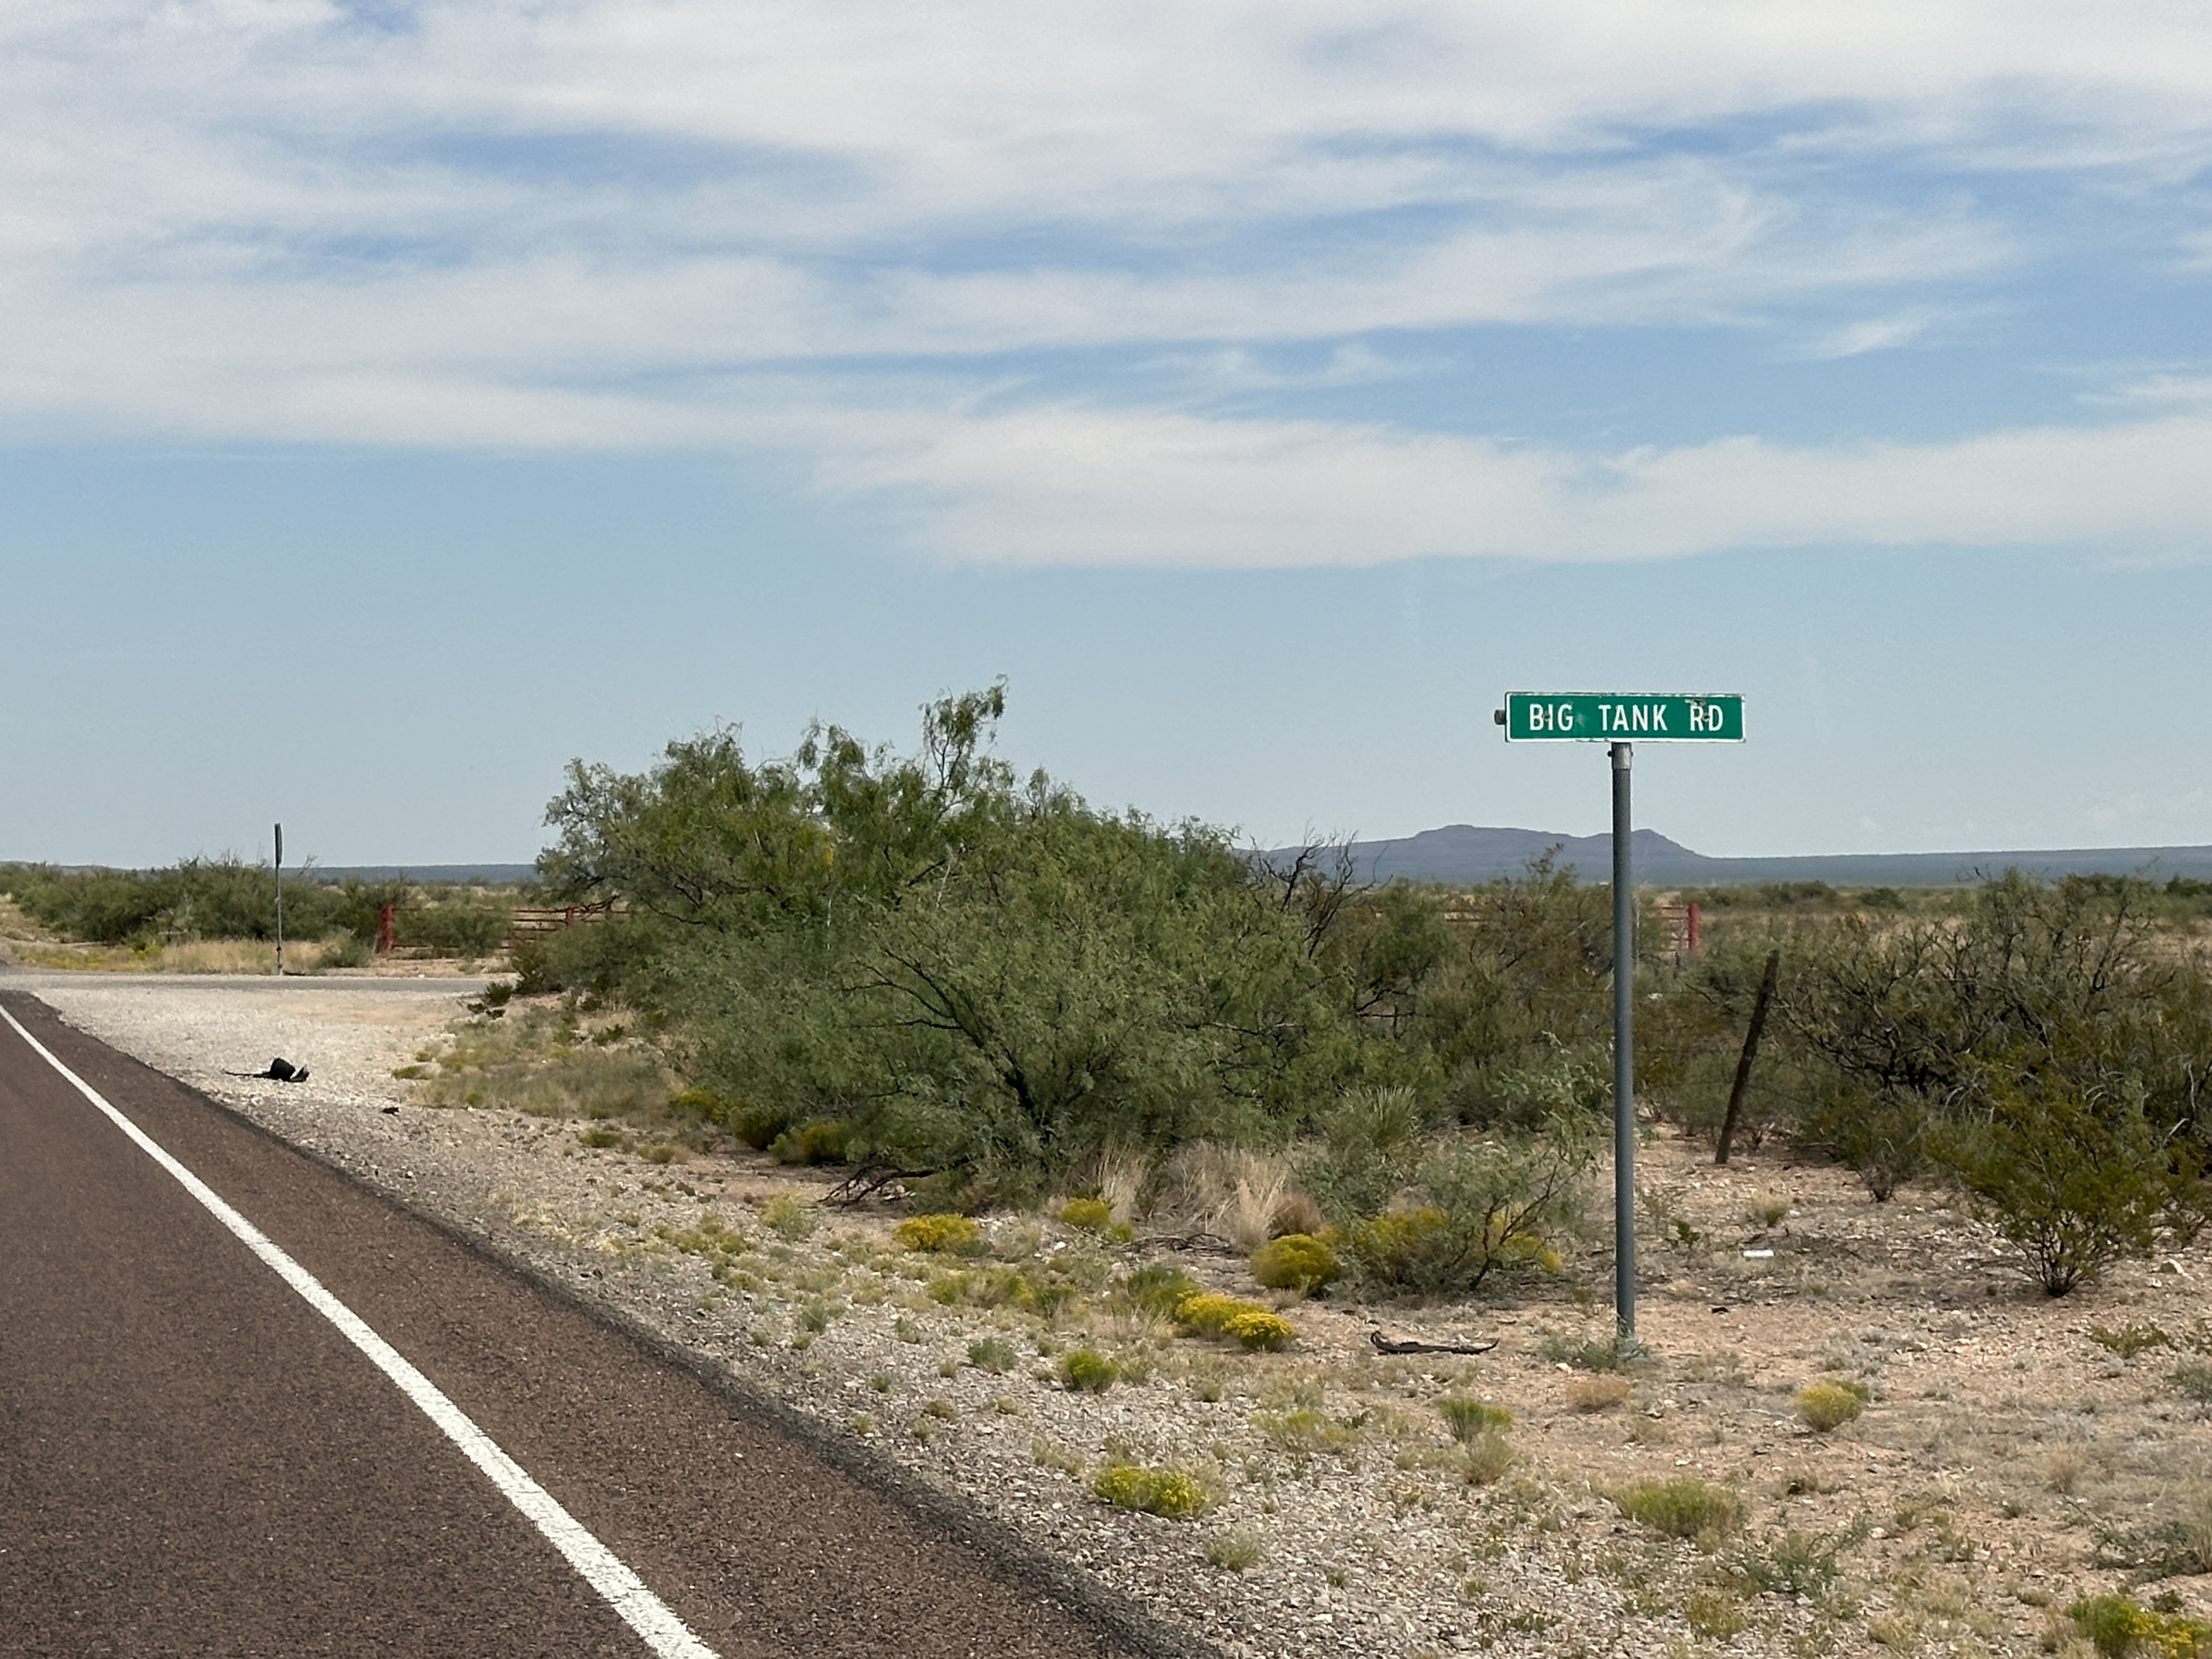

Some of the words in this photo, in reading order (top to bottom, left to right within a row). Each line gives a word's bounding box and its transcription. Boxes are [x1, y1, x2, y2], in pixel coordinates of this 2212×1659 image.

[1530, 704, 1573, 731] BIG
[1598, 704, 1668, 731] TANK
[1690, 704, 1723, 731] RD
